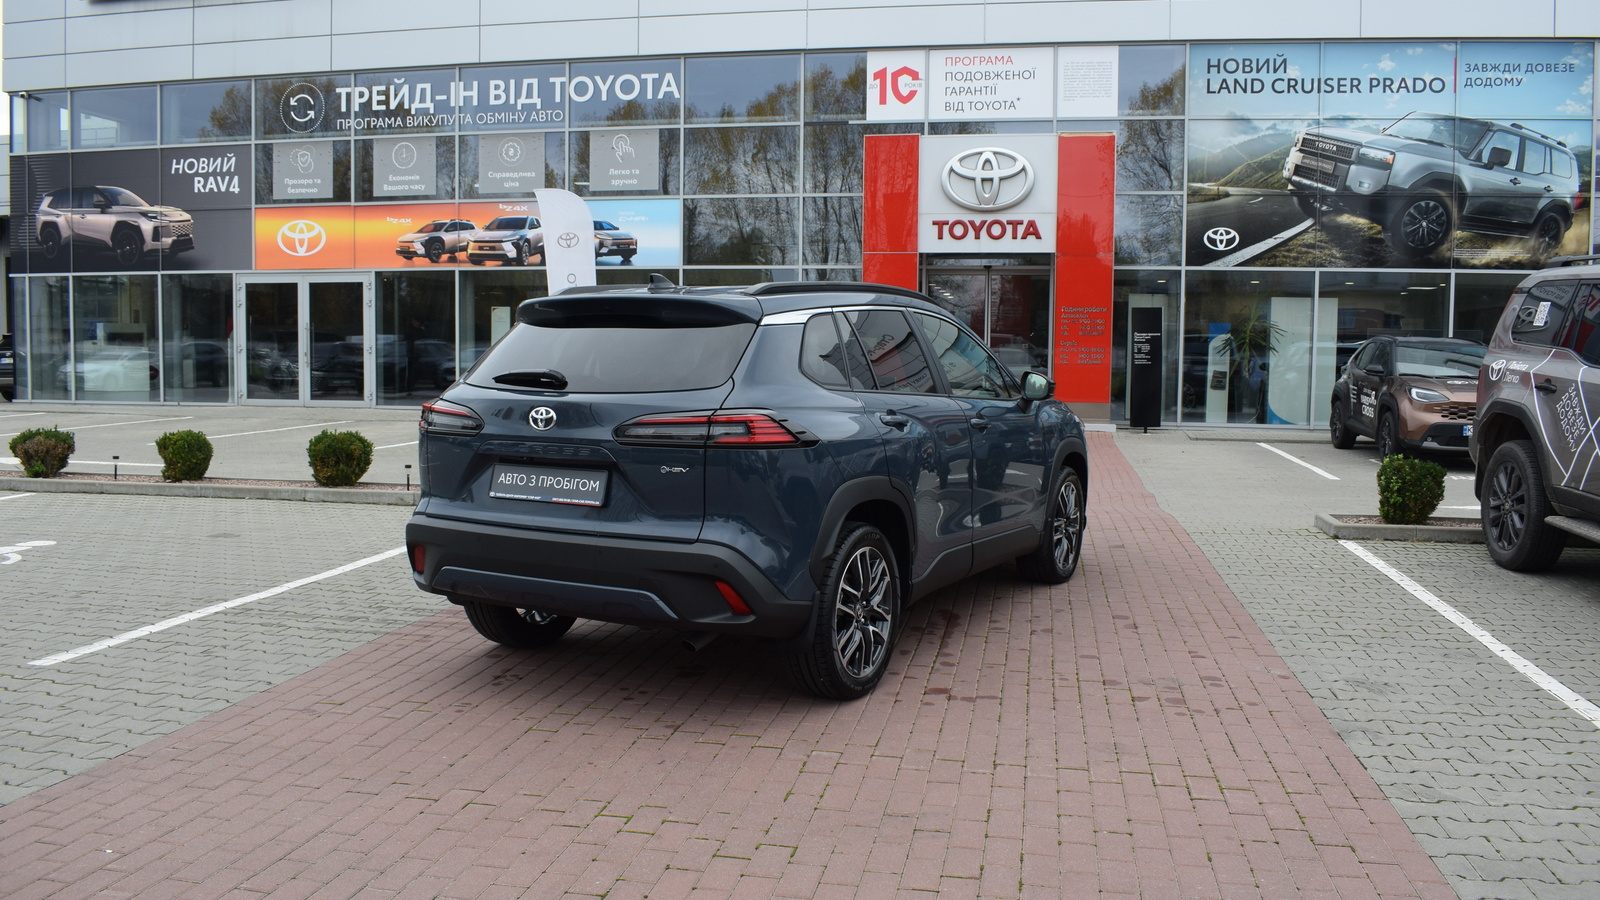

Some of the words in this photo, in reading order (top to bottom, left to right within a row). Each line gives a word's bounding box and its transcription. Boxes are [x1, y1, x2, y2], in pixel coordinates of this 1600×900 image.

[945, 56, 1014, 66] ПРОГРАМА
[1207, 54, 1287, 74] НОВИЙ
[1464, 63, 1521, 74] ЗАВЖДИ
[1524, 63, 1575, 74] ДОВЕЗЕ
[945, 67, 1036, 83] ПОДОВЖЕНОЇ
[1464, 77, 1523, 88] ДОДОМУ
[945, 83, 997, 96] ГАРАНТІЇ
[1206, 78, 1265, 94] LAND
[1271, 77, 1362, 94] CRUISER
[1369, 77, 1446, 94] PRADO
[336, 78, 478, 115] ТРЕЙД-ІН
[489, 78, 542, 110] ВІД
[550, 73, 681, 102] TOYOTA
[945, 101, 964, 113] ВІД
[337, 116, 404, 130] ПРОГРАМА
[406, 114, 456, 127] ВИКУПУ
[459, 113, 473, 125] ТА
[476, 111, 527, 124] ОБМІНУ
[530, 110, 564, 122] АВТО
[171, 153, 236, 175] НОВИЙ
[609, 168, 630, 176] Легко
[488, 171, 535, 179] Справедлива
[611, 178, 638, 186] зручно
[194, 176, 240, 194] RAV4
[287, 186, 318, 194] безпечно
[410, 183, 426, 191] часу
[503, 180, 520, 188] ціна
[932, 219, 1042, 240] TOYOTA
[1561, 392, 1580, 440] ДОВЕЗЕ
[1568, 383, 1587, 435] ЗАВЖДИ
[1556, 402, 1577, 452] ДОДОМУ
[498, 473, 527, 486] АВТО
[538, 475, 600, 492] ПРОБІГОМ
